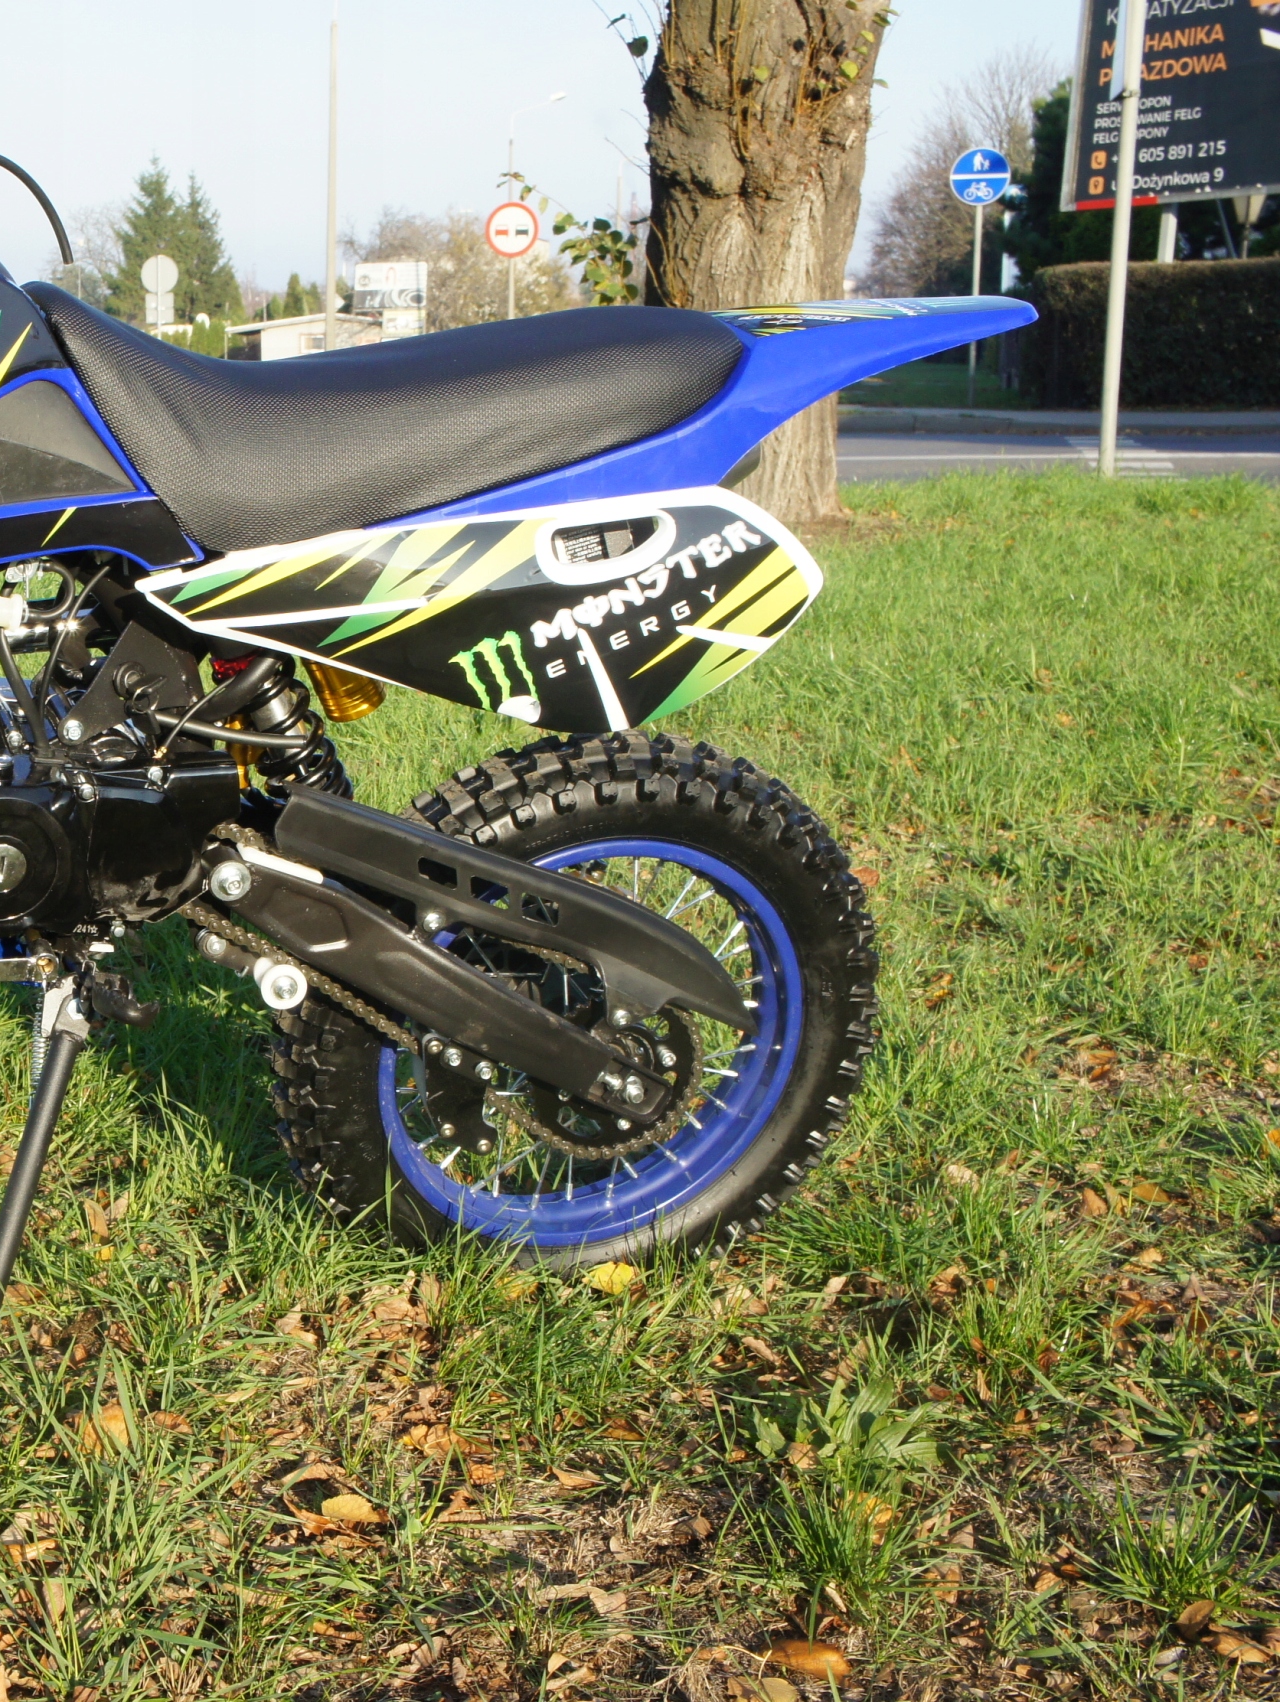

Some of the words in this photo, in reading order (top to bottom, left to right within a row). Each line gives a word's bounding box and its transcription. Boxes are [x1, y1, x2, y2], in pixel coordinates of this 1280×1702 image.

[1101, 23, 1225, 59] MHANIKA
[1099, 52, 1228, 87] PAZDOWA
[1174, 107, 1202, 121] FELG
[1138, 146, 1165, 163] 605
[1167, 144, 1193, 161] 891
[1198, 140, 1226, 158] 215
[1132, 170, 1210, 191] Dożynkowa
[1213, 167, 1224, 183] 9
[530, 520, 762, 648] MONSTER
